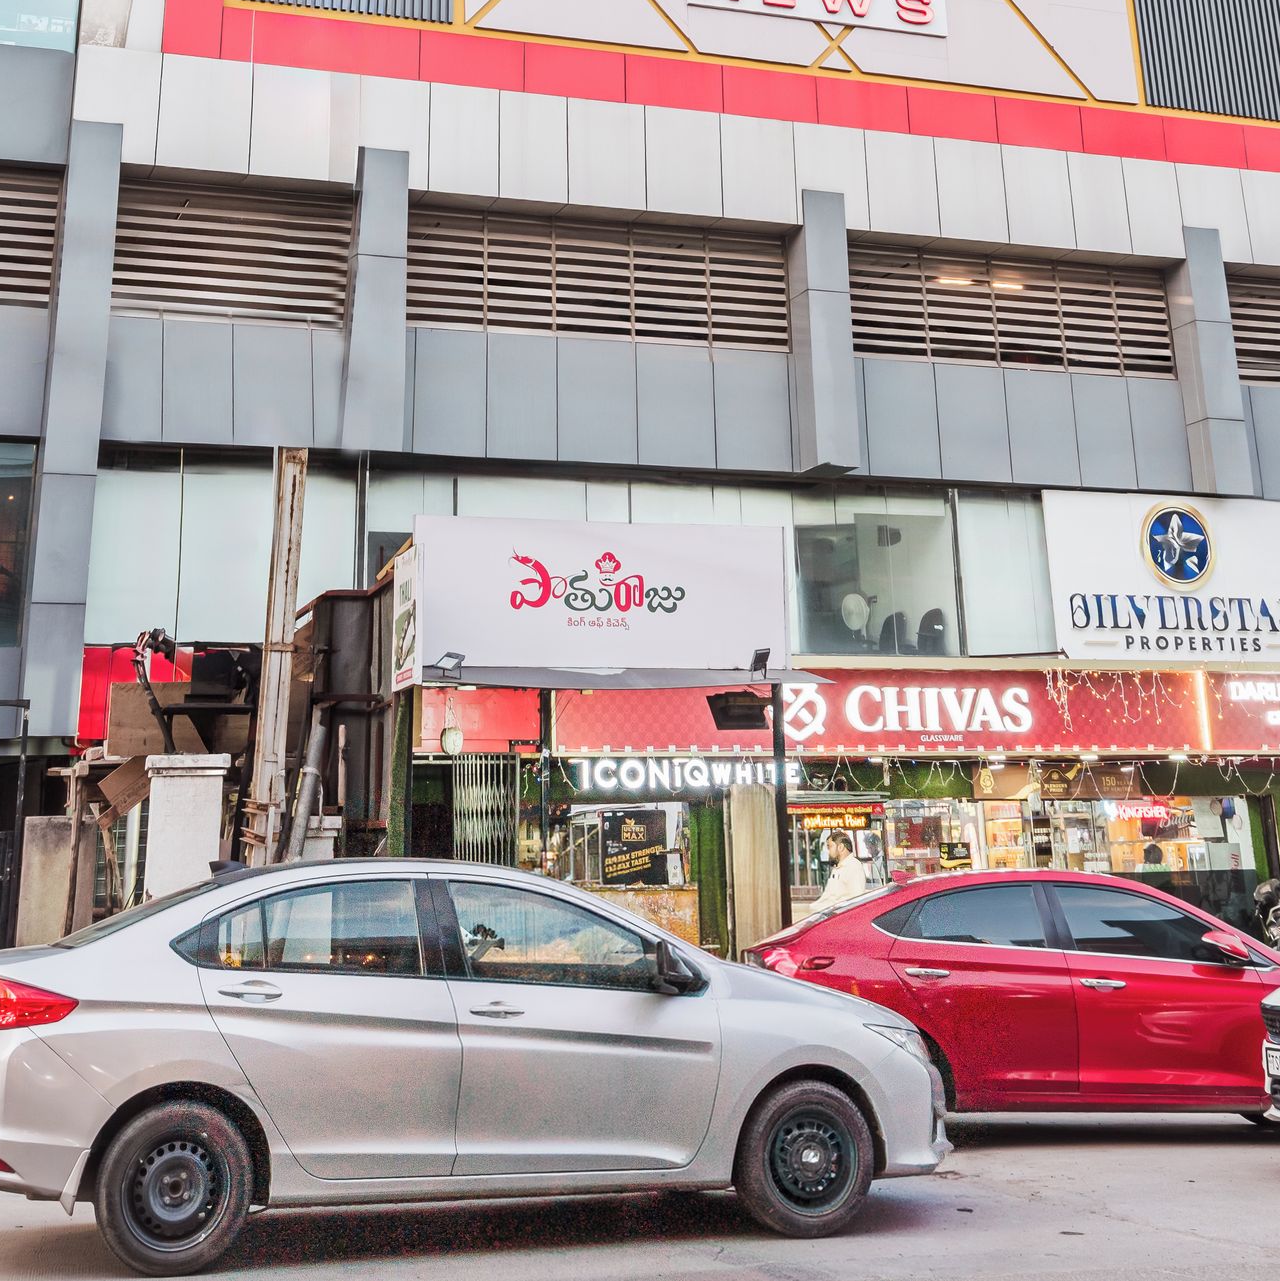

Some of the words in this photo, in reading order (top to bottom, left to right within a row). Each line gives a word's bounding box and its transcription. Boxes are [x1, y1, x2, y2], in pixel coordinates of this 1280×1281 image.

[1125, 635, 1262, 652] PROPERTIES
[845, 684, 1033, 733] CHIVAS
[920, 734, 964, 742] GLASSWARE
[1101, 776, 1116, 786] 150
[1118, 805, 1168, 820] KINGFISHER
[623, 832, 644, 840] MAX
